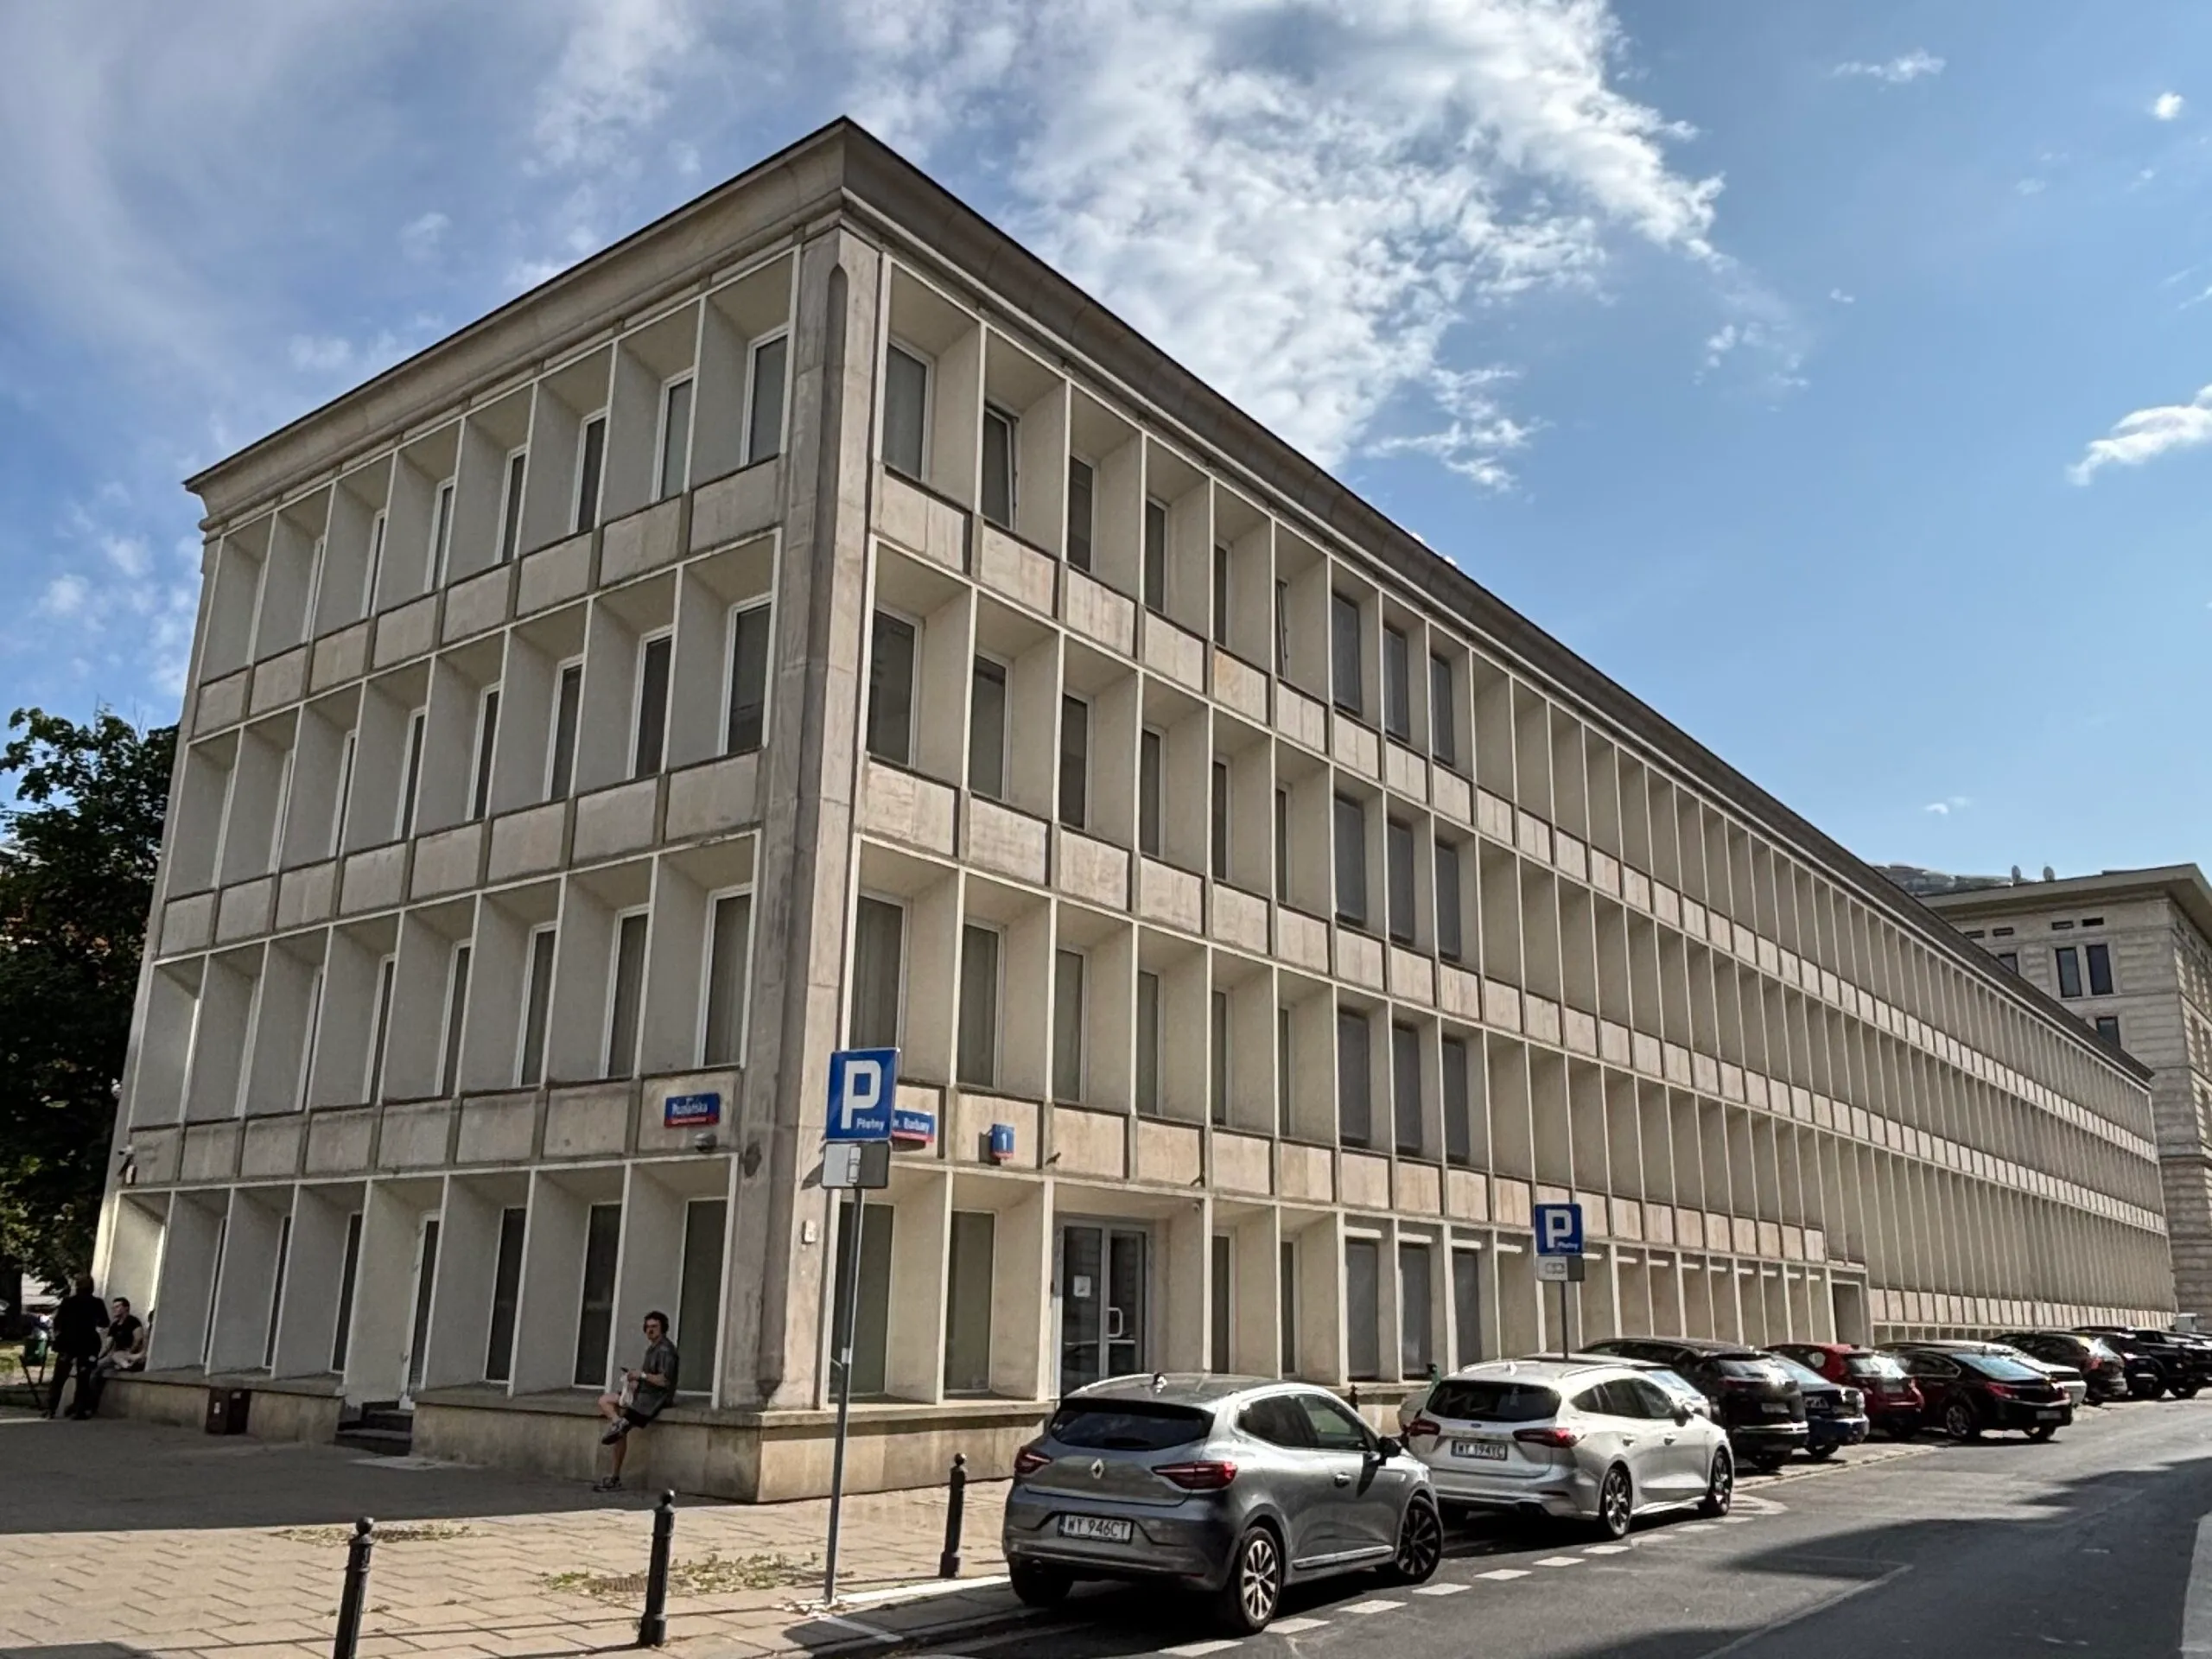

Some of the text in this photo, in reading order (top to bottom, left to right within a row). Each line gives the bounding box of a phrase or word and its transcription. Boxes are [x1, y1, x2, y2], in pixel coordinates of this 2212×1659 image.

[841, 1060, 882, 1130] P
[1545, 1209, 1573, 1249] P
[1067, 1516, 1128, 1538] WY 946CT
